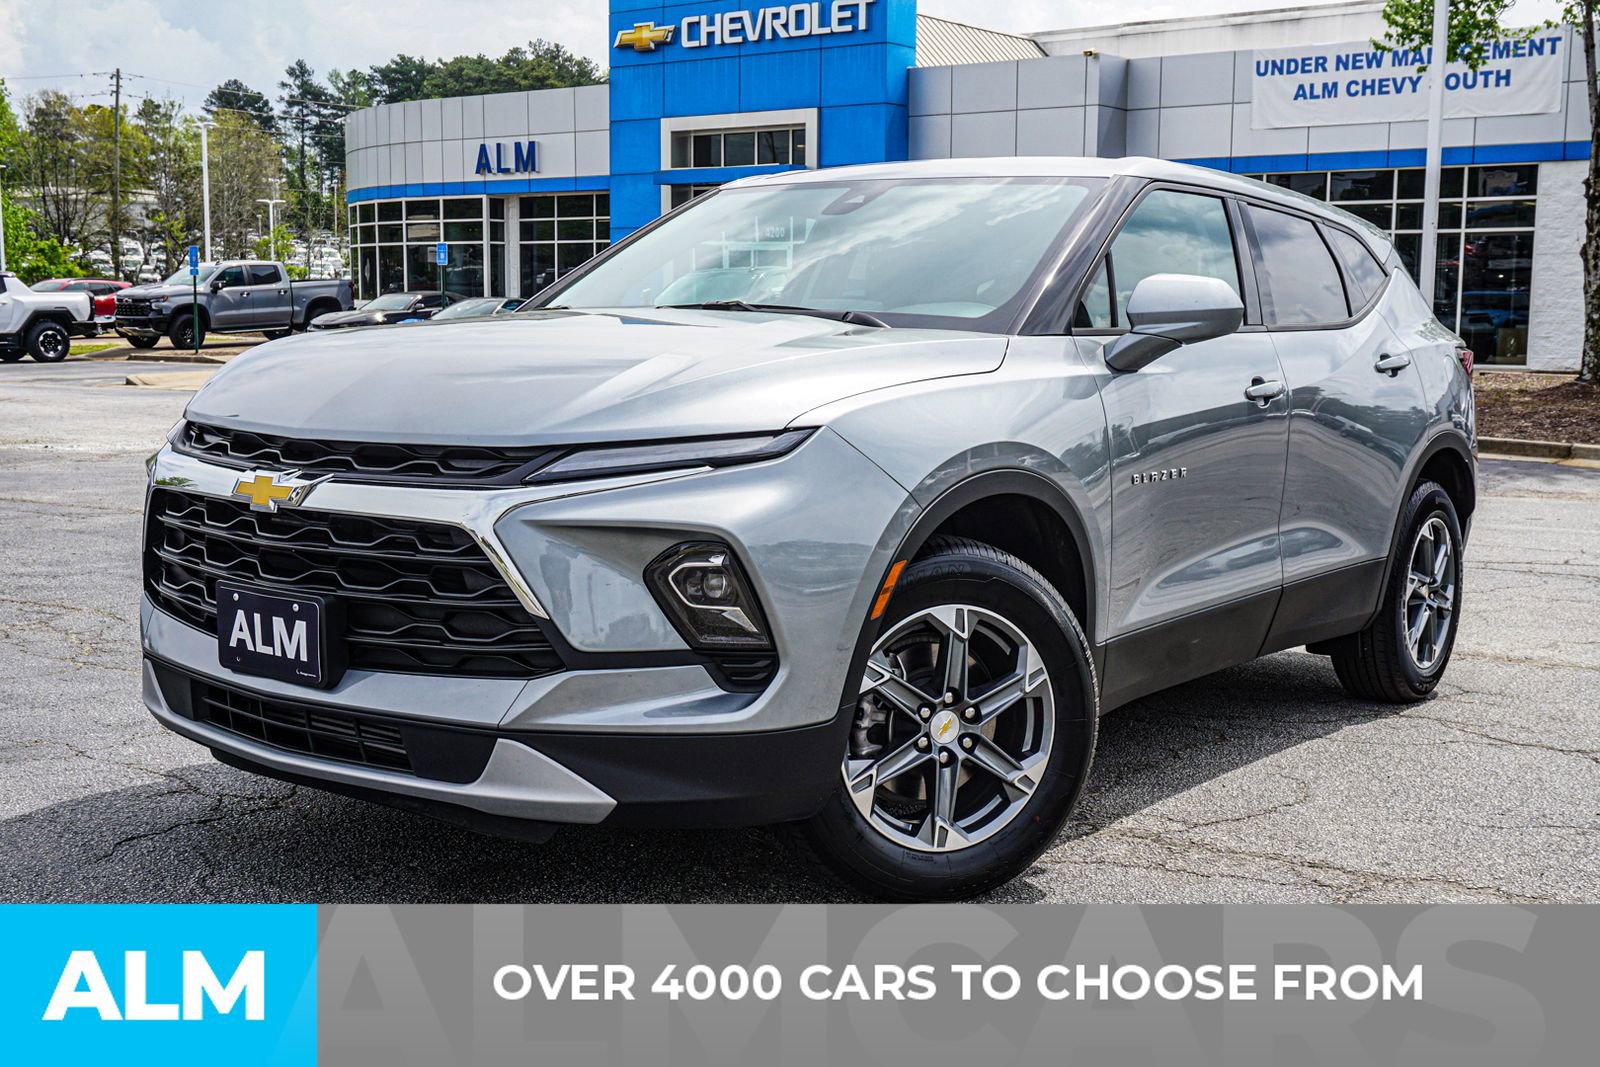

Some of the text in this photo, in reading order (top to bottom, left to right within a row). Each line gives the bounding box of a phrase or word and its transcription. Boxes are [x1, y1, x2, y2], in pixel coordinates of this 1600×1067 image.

[681, 0, 876, 48] CHEVROLET
[1255, 55, 1328, 77] UNDER
[1335, 50, 1387, 72] NEW
[1293, 69, 1512, 101] ALM CHEVY OUTH
[475, 141, 537, 174] ALM
[1131, 467, 1187, 485] BLAZER
[229, 609, 308, 662] ALM
